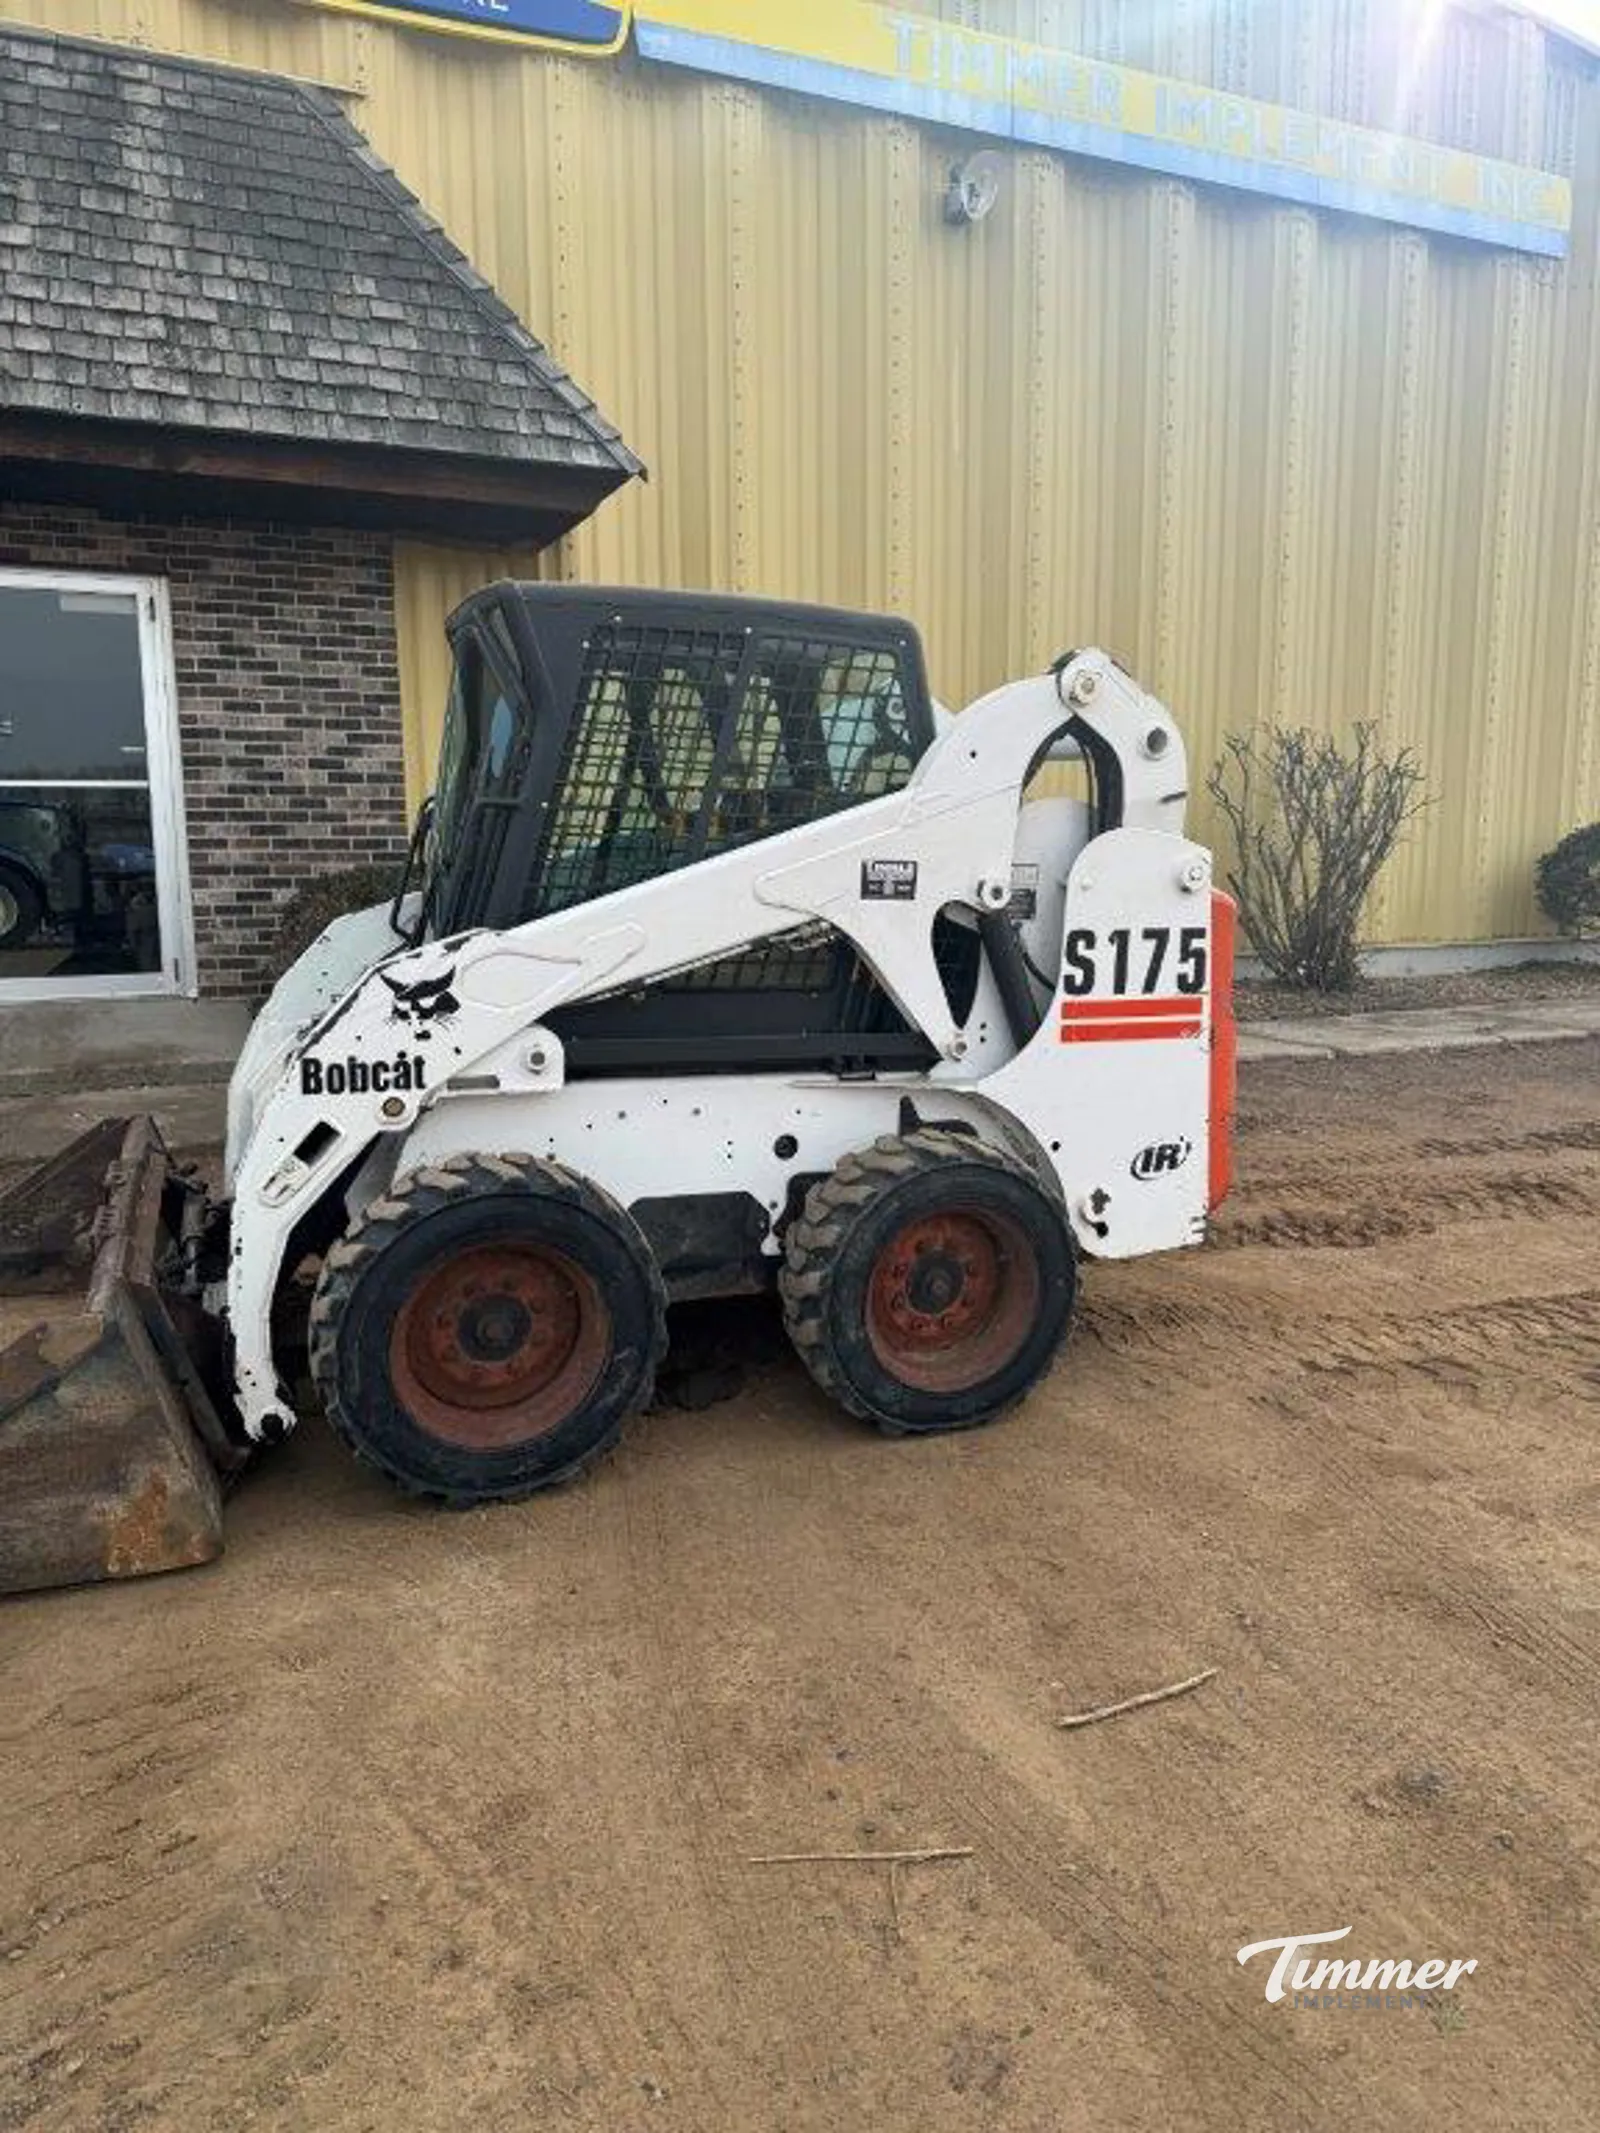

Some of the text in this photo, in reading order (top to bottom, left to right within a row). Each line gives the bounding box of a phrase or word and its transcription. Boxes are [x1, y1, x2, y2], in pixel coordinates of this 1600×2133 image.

[891, 16, 1122, 122] TIMMER
[1154, 85, 1443, 199] IMPLEMENT
[1063, 928, 1207, 996] S175
[301, 1052, 426, 1095] Bobcat
[1142, 1144, 1183, 1174] IR
